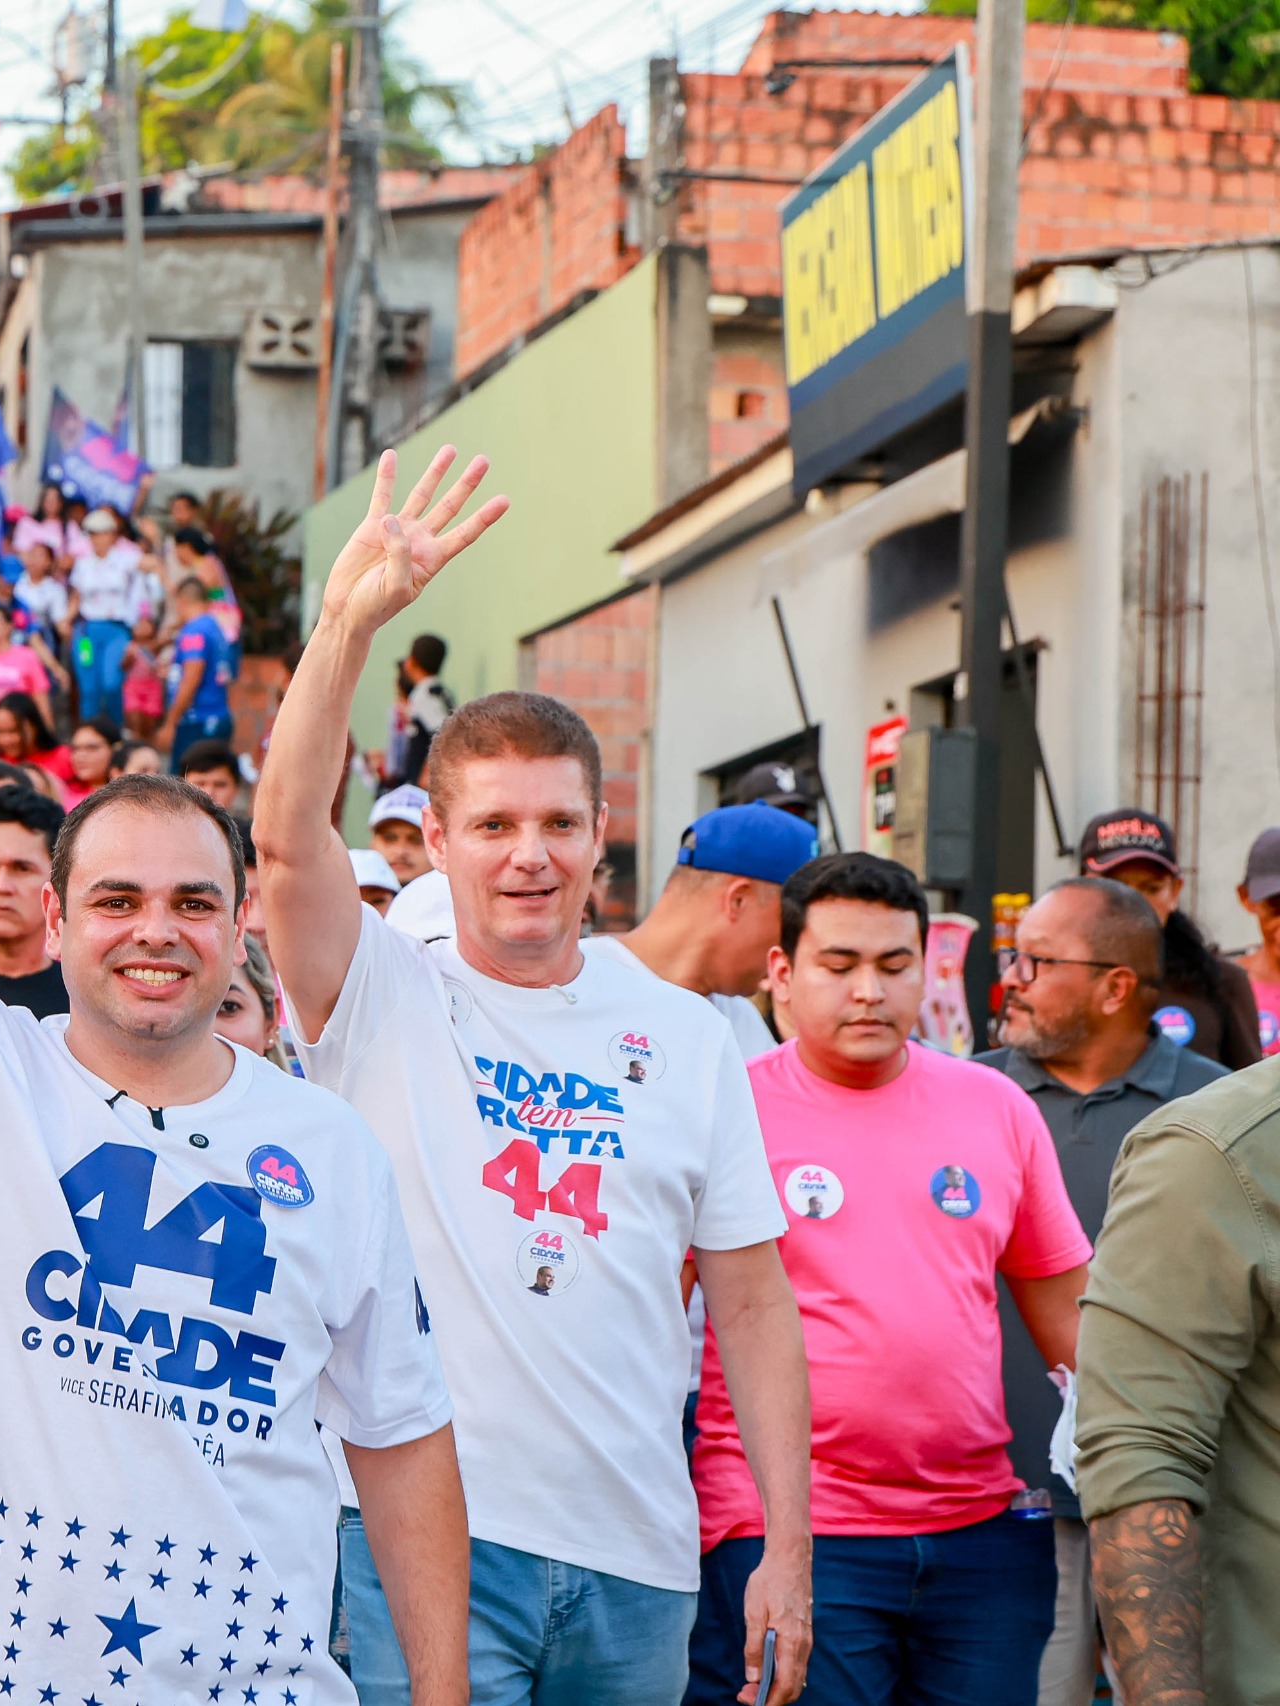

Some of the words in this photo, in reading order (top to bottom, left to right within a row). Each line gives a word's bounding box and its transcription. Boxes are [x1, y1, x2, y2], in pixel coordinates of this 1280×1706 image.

[619, 1044, 653, 1057] CIDADE
[622, 1033, 649, 1049] 44
[516, 1094, 578, 1128] tem
[260, 1155, 298, 1187] 44
[801, 1171, 823, 1182] 44
[255, 1172, 304, 1197] CIDADE
[482, 1138, 609, 1242] 44
[59, 1141, 277, 1316] 44
[534, 1231, 563, 1252] 44
[530, 1246, 566, 1262] CIDADE
[22, 1326, 273, 1441] GOVEADOR
[60, 1377, 86, 1396] VICE
